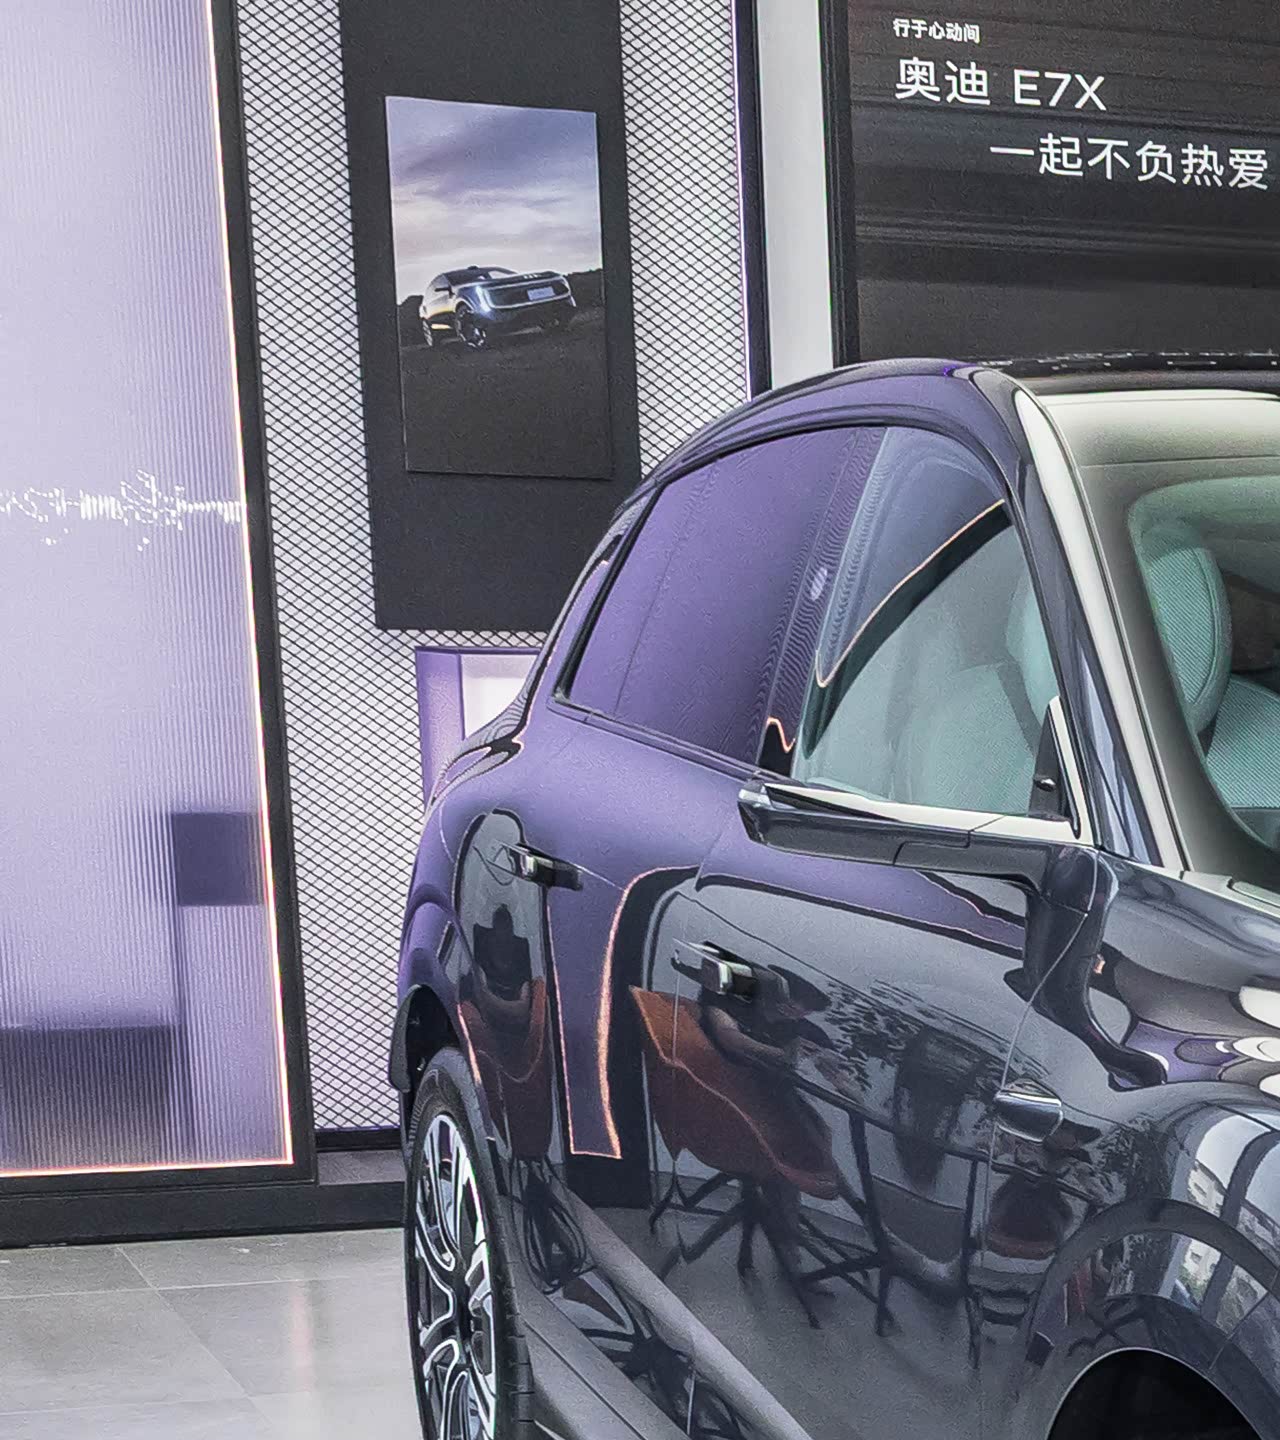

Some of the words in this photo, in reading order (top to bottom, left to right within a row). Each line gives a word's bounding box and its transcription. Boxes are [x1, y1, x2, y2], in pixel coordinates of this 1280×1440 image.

[893, 18, 981, 44] 行于心动间
[895, 57, 991, 106] 奥迪
[1013, 68, 1107, 111] E7X
[990, 132, 1269, 191] 一起不负热爱
